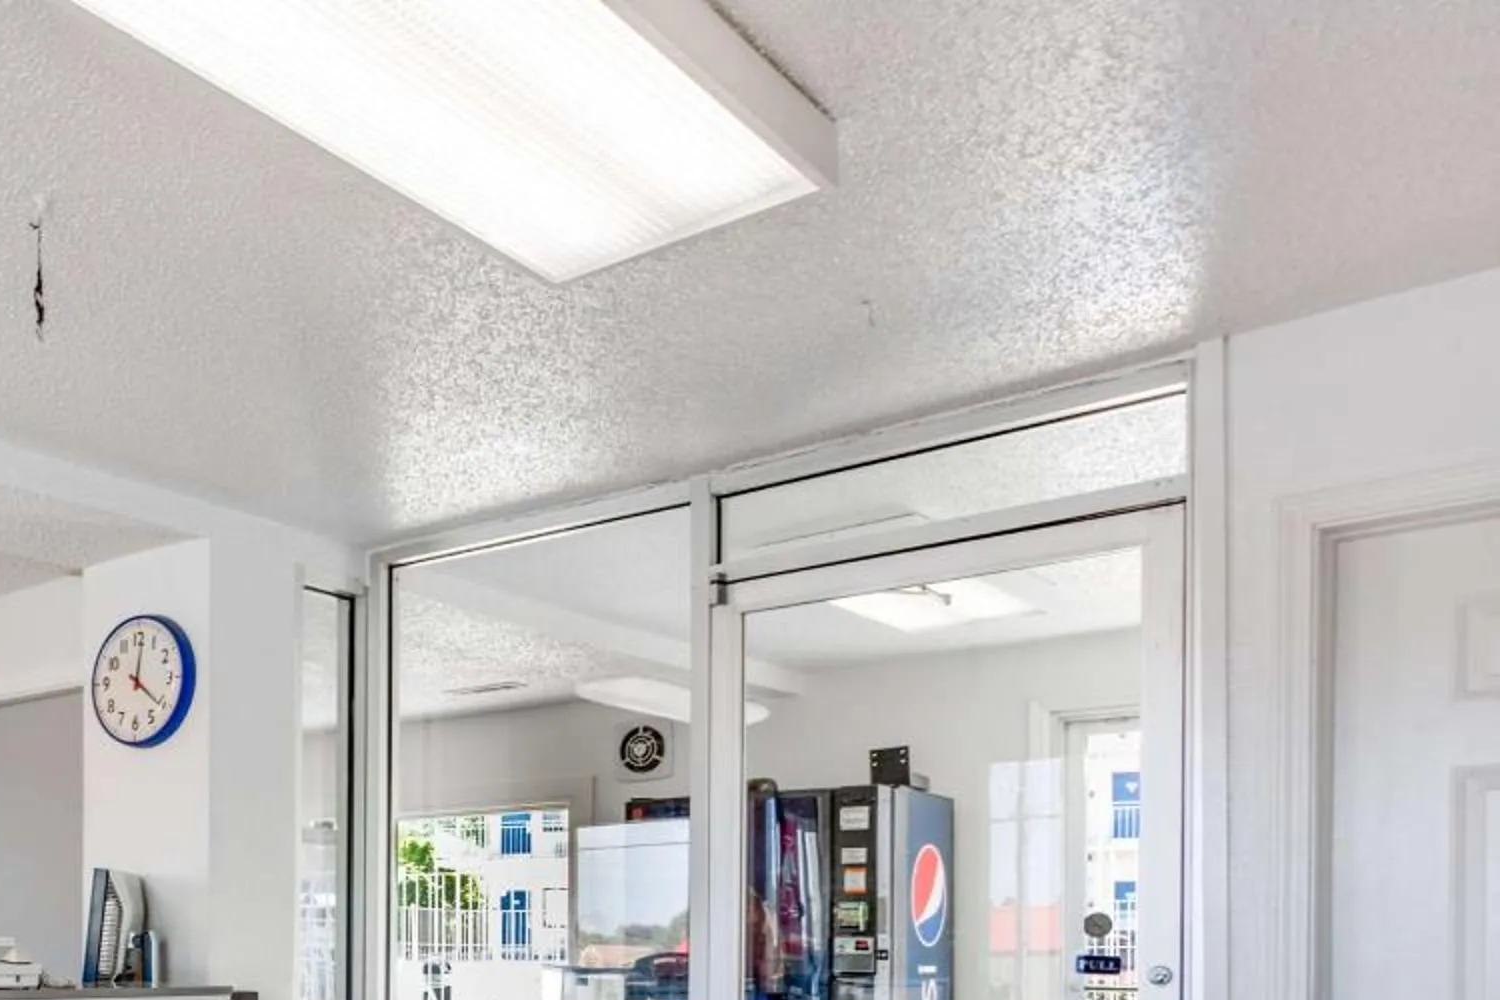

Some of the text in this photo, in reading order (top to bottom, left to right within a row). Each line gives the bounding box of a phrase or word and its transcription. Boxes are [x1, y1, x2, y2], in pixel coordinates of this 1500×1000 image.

[133, 632, 144, 647] 12
[151, 635, 157, 650] 1
[108, 656, 120, 671] 10
[161, 648, 169, 664] 2
[102, 676, 110, 692] 9
[107, 698, 115, 713] 8
[118, 711, 125, 726] 7
[131, 715, 139, 731] 6
[147, 709, 155, 725] 5
